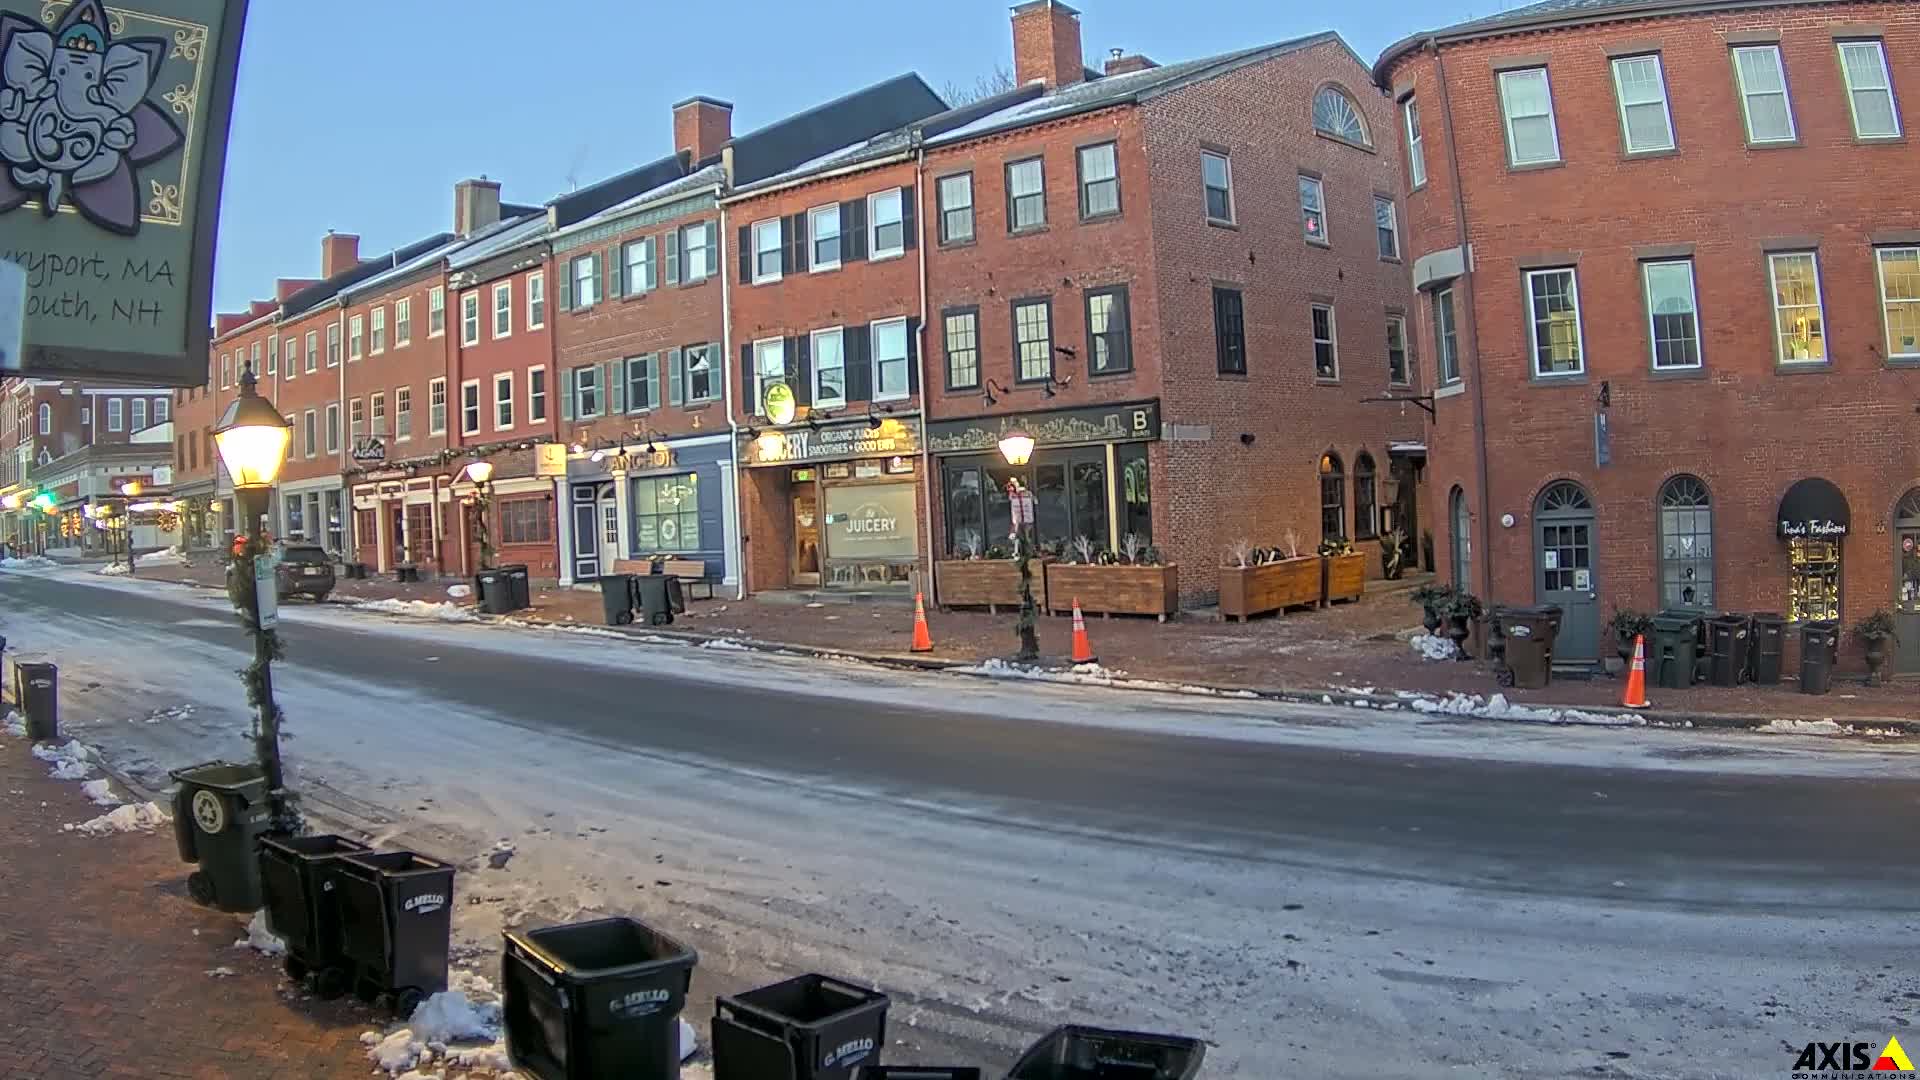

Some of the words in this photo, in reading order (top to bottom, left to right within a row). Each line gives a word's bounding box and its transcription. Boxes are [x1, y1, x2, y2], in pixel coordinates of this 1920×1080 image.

[121, 258, 175, 288] MA
[112, 299, 163, 326] NH
[820, 430, 853, 443] ORGANIC
[808, 442, 849, 457] SMOOTHIES
[853, 439, 877, 453] GOOD
[846, 517, 897, 533] JUICERY
[1782, 520, 1806, 535] Tina's
[1809, 519, 1846, 534] Fashions
[414, 894, 444, 906] MELLO
[624, 988, 669, 1007] MELLO
[836, 1038, 874, 1060] MELLO
